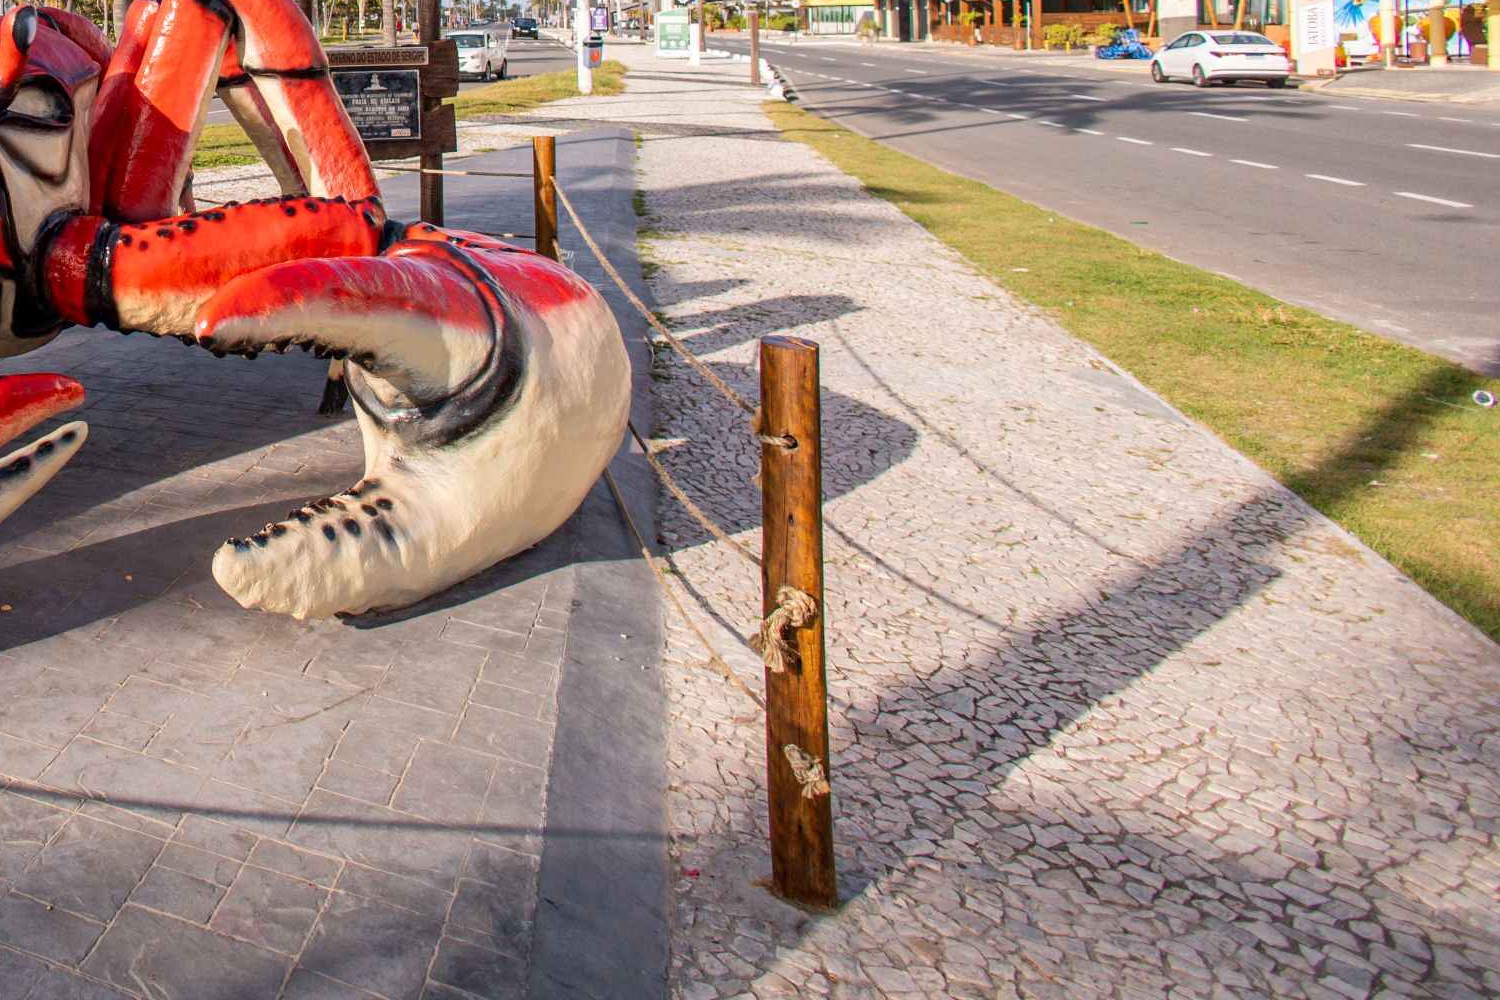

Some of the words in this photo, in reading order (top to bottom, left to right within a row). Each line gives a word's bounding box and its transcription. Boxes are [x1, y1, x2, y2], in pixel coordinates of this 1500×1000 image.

[327, 52, 355, 63] GOVERNO
[357, 52, 366, 62] DO
[368, 51, 390, 62] ESTADO
[392, 51, 400, 62] DE
[401, 50, 425, 62] SERGIPE
